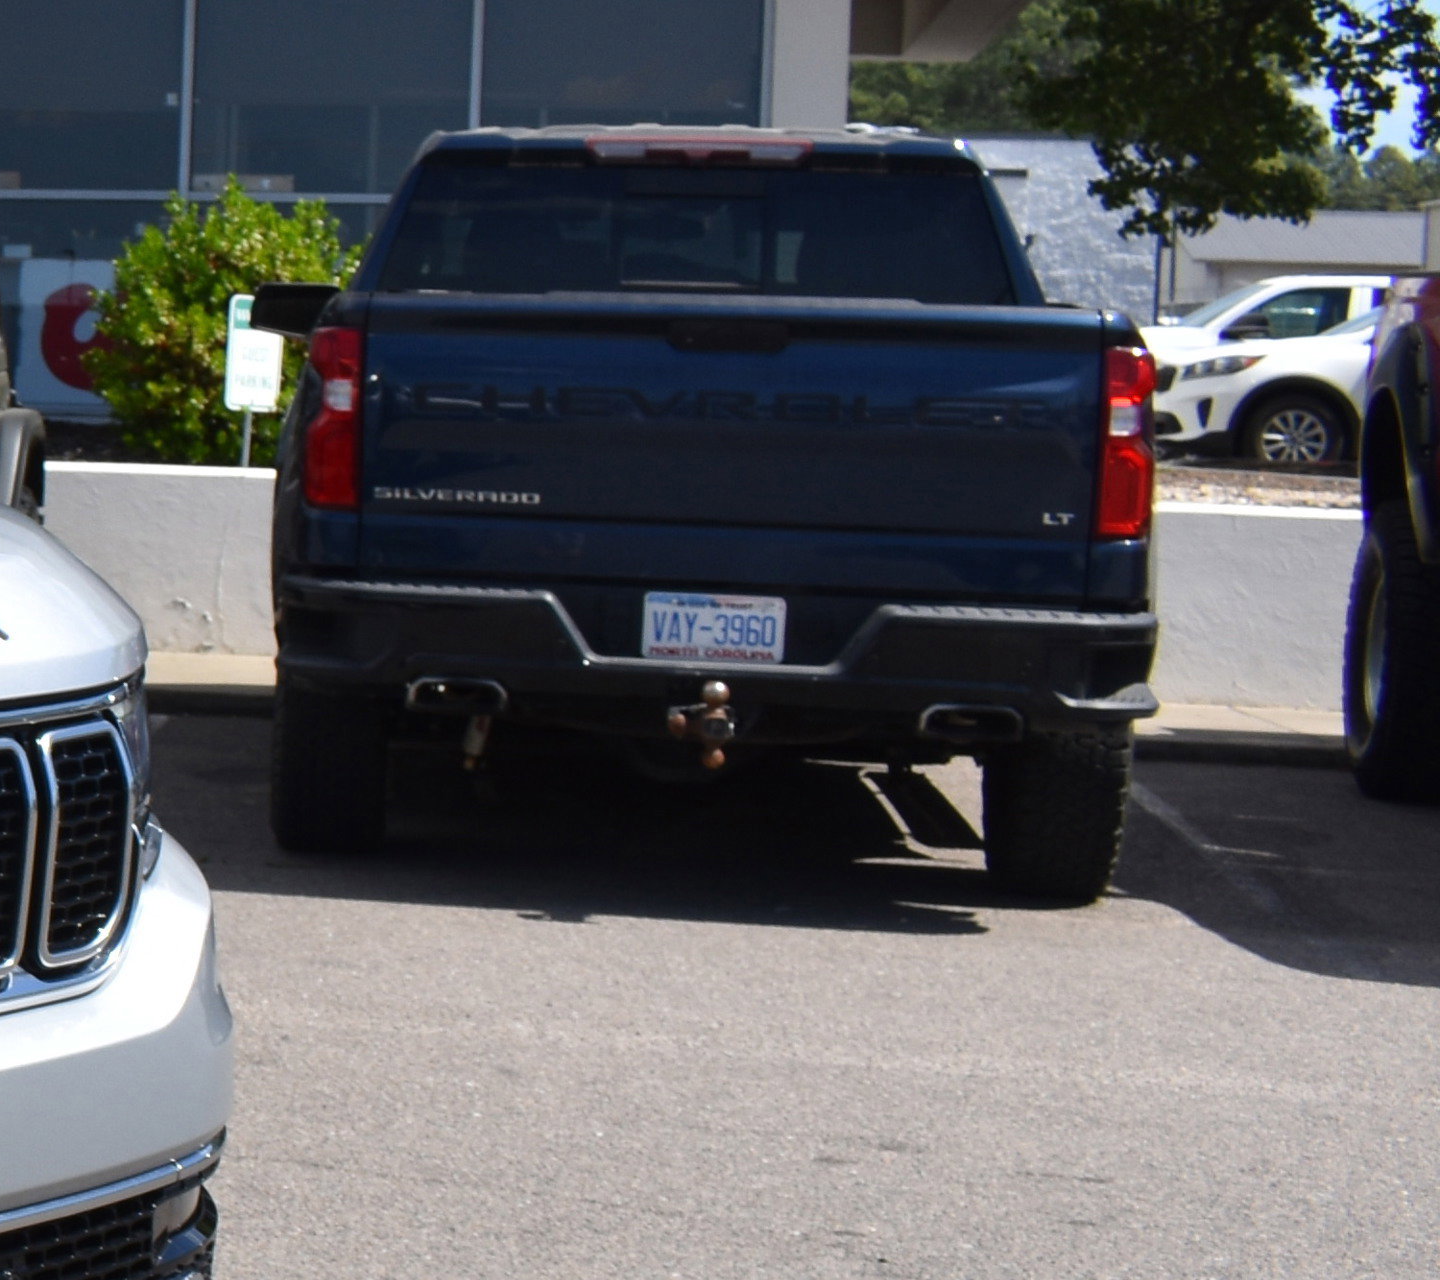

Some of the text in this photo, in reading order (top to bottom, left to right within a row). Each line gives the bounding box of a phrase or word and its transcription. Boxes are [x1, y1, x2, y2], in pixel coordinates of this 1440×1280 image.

[412, 382, 1047, 428] CHEVROLET
[373, 486, 541, 504] SILVERADO
[1042, 512, 1075, 525] LT
[653, 610, 777, 647] VAY-3960
[650, 646, 775, 660] NORTH CAROLINA
